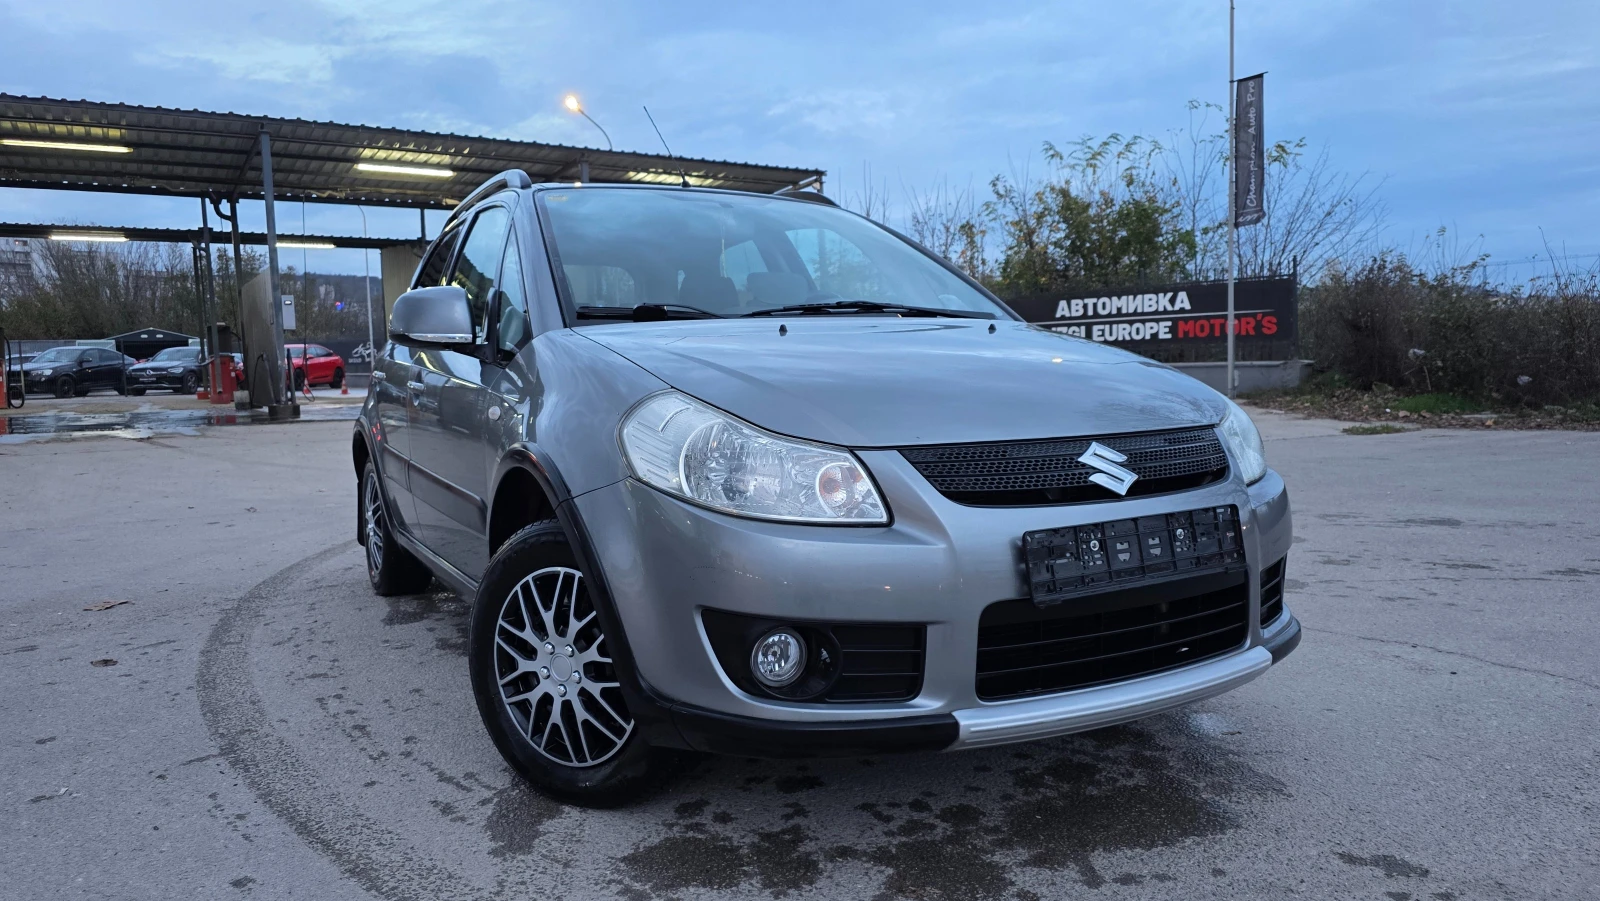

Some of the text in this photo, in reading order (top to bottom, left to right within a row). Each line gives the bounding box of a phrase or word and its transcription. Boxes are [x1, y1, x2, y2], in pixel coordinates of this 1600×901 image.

[1246, 80, 1258, 207] Champion Auto Pro
[1055, 291, 1191, 318] АВТОМИВКА
[1092, 321, 1172, 342] EUROPE
[1177, 313, 1278, 339] MOTOR'S
